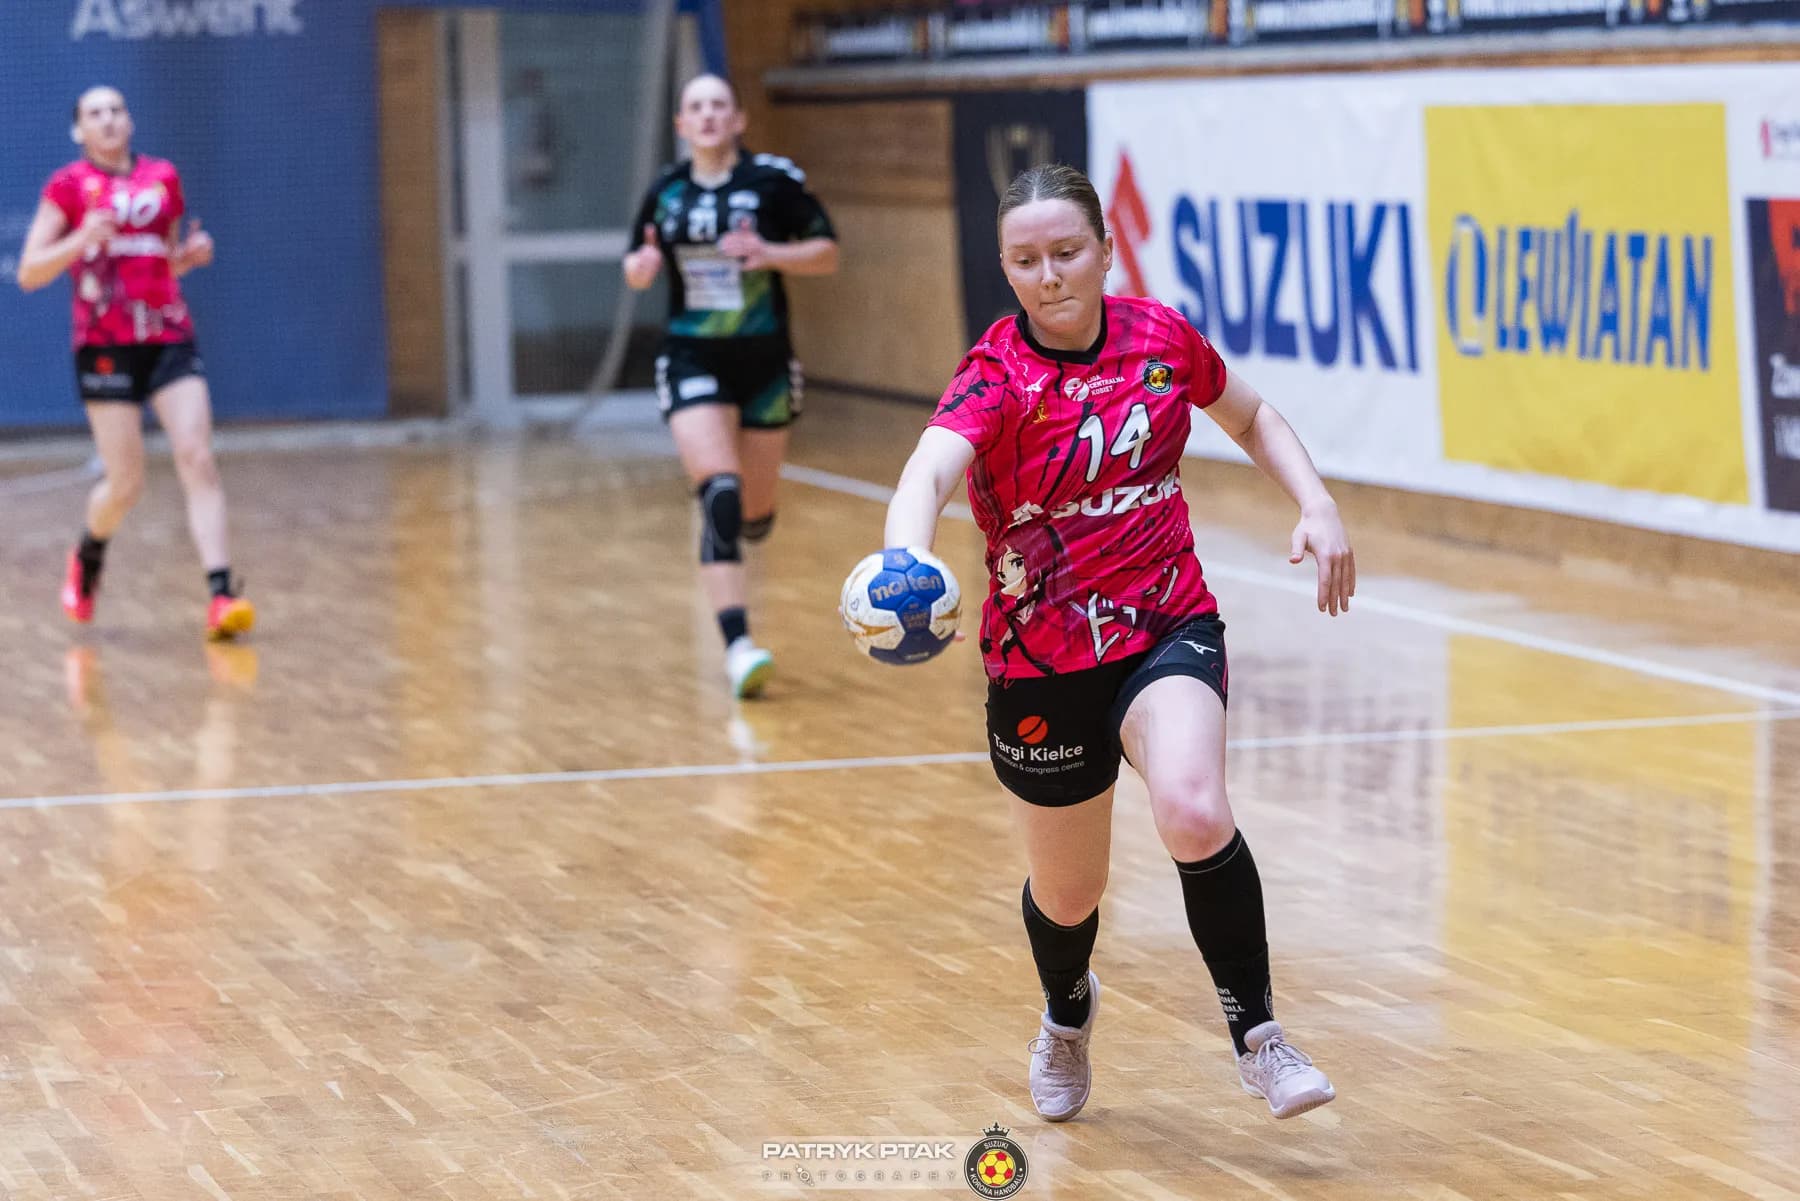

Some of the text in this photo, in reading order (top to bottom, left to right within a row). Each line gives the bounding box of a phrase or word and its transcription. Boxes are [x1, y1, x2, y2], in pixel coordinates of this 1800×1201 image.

[1173, 196, 1418, 373] SUZUKI
[1496, 207, 1713, 371] LEWIATAN
[1088, 376, 1126, 389] CENTRALNA
[1091, 385, 1113, 396] KOBIET
[1078, 403, 1153, 482] 14
[993, 733, 1024, 761] Targi
[1030, 745, 1084, 761] Kielce
[1025, 765, 1060, 775] congress
[1061, 760, 1085, 771] centre
